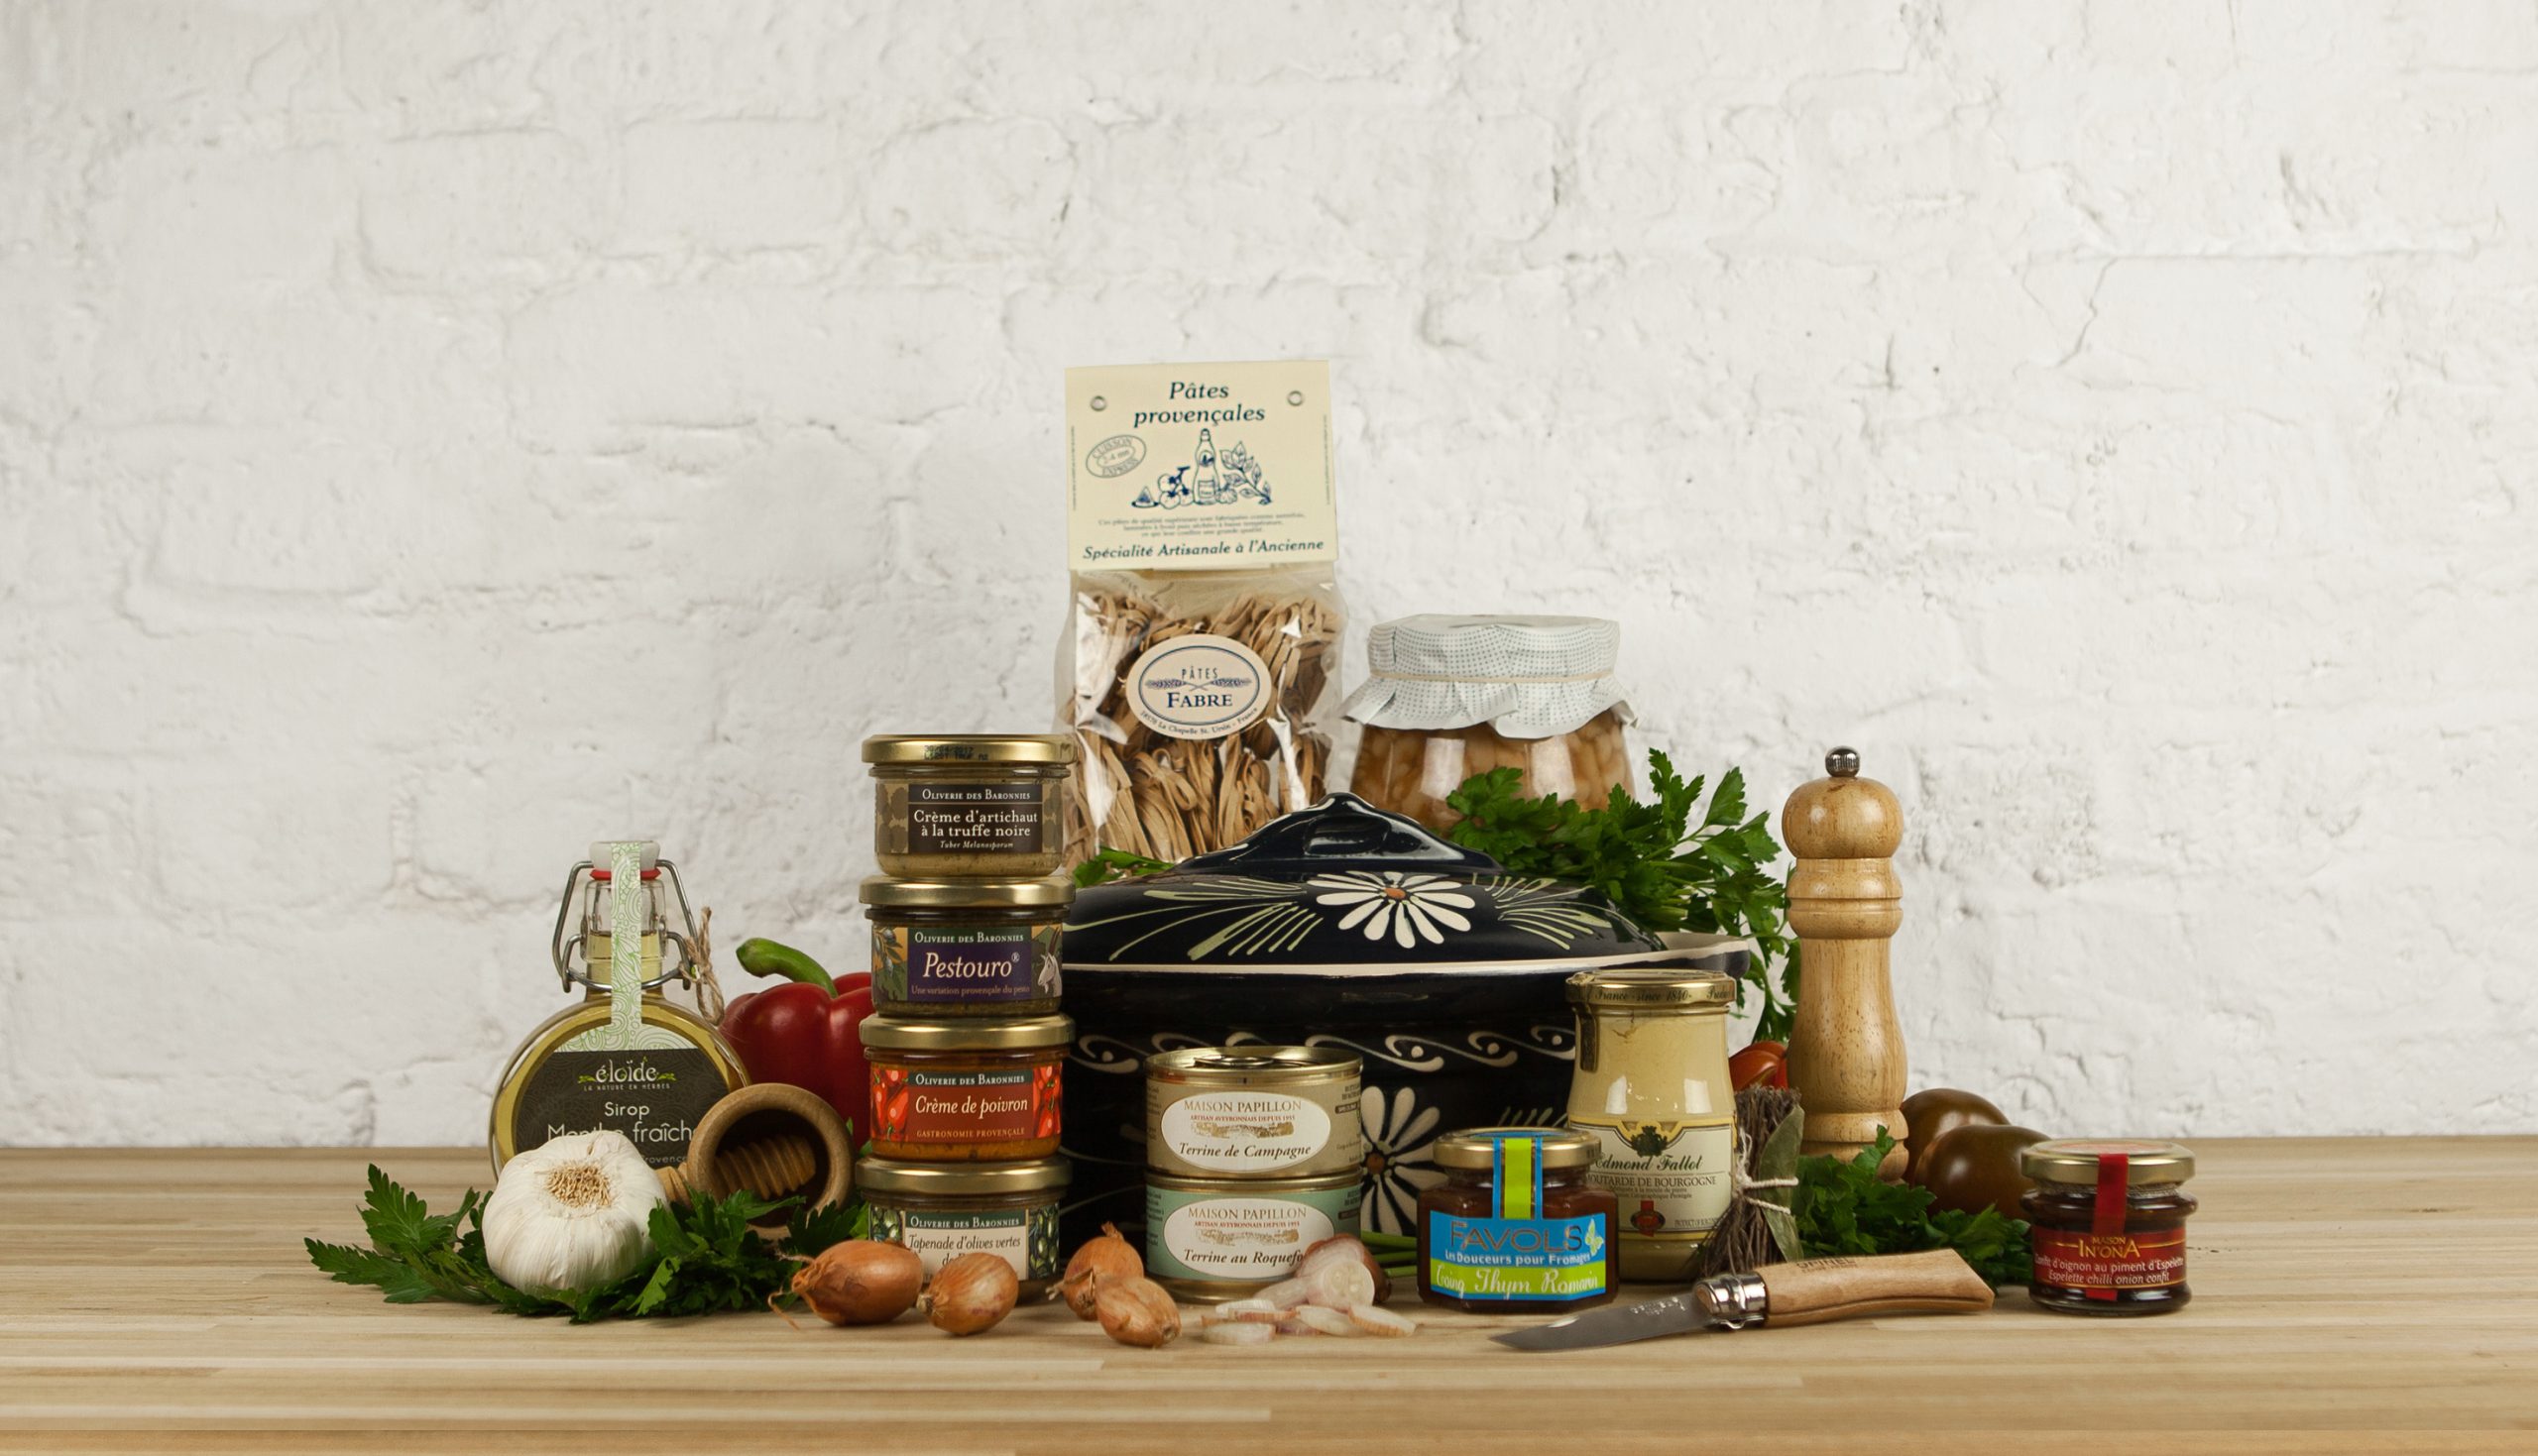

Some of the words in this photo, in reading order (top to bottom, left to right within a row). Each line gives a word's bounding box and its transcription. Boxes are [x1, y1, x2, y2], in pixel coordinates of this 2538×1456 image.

[1169, 381, 1229, 400] Pâtes
[1133, 403, 1266, 428] provençales
[1083, 544, 1154, 561] Spécialité
[1158, 541, 1231, 557] Artisanale
[1235, 542, 1244, 554] à
[1182, 665, 1219, 680] PÂTES
[1167, 692, 1233, 709] FABRE
[922, 788, 965, 800] OLIVERIE
[984, 788, 1031, 800] BARONNIES
[913, 809, 961, 824] Crème
[965, 809, 1038, 824] d'artichaut
[921, 825, 928, 837] à
[932, 824, 944, 837] la
[949, 824, 991, 837] truffe
[995, 825, 1031, 837] noire
[914, 932, 956, 944] OLIVERIE
[958, 935, 975, 944] DES
[977, 932, 1024, 943] BARONNIES
[915, 1073, 957, 1085] OLIVERIE
[959, 1076, 976, 1085] DES
[979, 1073, 1025, 1085] BARONNIES
[604, 1101, 650, 1120] Sirop
[915, 1095, 958, 1114] Crème
[961, 1095, 977, 1114] de
[979, 1095, 1028, 1119] poivron
[1184, 1099, 1233, 1112] MAISON
[1237, 1099, 1302, 1112] PAPILLON
[633, 1119, 697, 1143] fraîch
[916, 1129, 975, 1139] GASTRONOMIE
[1180, 1142, 1221, 1158] Terrine
[1224, 1143, 1240, 1158] de
[1244, 1144, 1312, 1160] Campagne
[1657, 1154, 1703, 1171] Fallot
[1637, 1176, 1653, 1186] DE
[1655, 1176, 1716, 1187] BOURGOGNE
[1189, 1207, 1238, 1219] MAISON
[1243, 1207, 1307, 1219] PAPILLON
[910, 1215, 951, 1228] OLIVERIE
[953, 1219, 970, 1228] DES
[972, 1216, 1020, 1228] BARONNIES
[908, 1234, 954, 1253] Tapenade
[956, 1235, 993, 1249] d'olives
[995, 1236, 1021, 1249] vertes
[1450, 1220, 1583, 1253] FAVOLS
[1184, 1249, 1227, 1264] Terrine
[1230, 1255, 1247, 1264] au
[1252, 1250, 1304, 1267] Roquefo
[1456, 1253, 1512, 1265] Douceurs
[1515, 1255, 1545, 1267] pour
[1549, 1252, 1591, 1266] Fromages
[2052, 1258, 2092, 1273] d'oignon
[2094, 1263, 2108, 1273] au
[2111, 1262, 2145, 1274] piment
[1474, 1268, 1531, 1300] Thym
[1541, 1269, 1598, 1293] Romarin
[2048, 1270, 2084, 1284] Espelette
[2087, 1273, 2113, 1285] chilli
[2115, 1273, 2143, 1285] onion
[2145, 1271, 2169, 1285] confit
